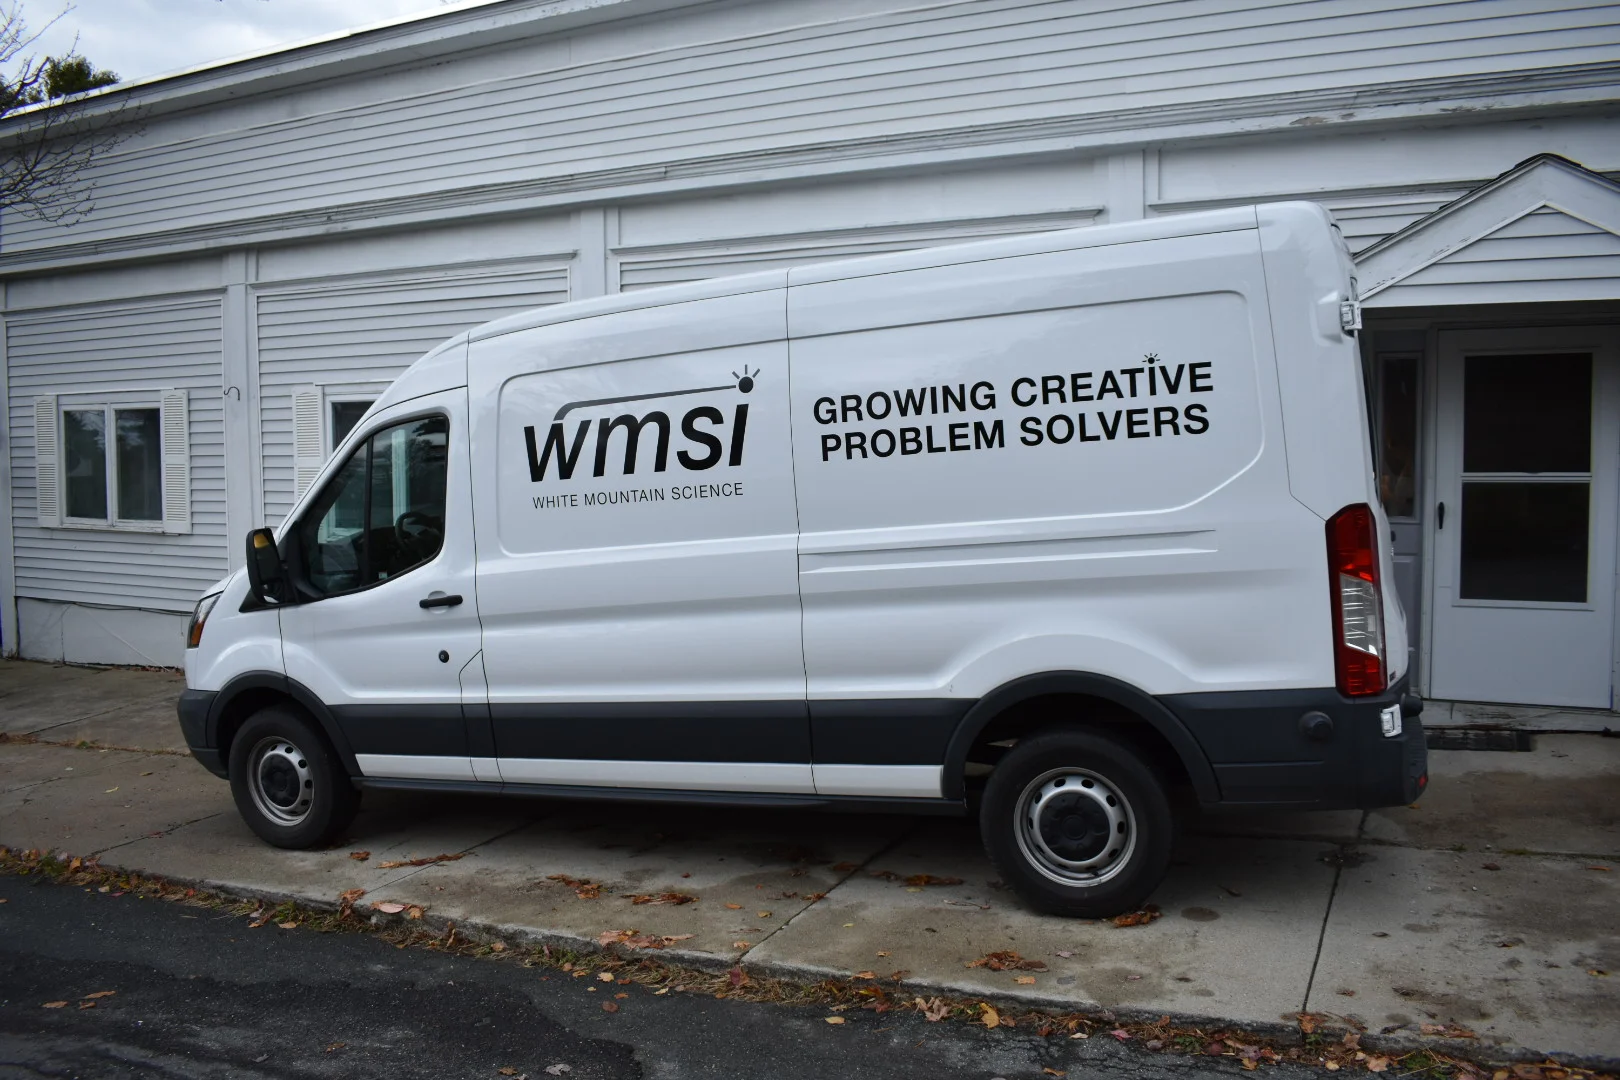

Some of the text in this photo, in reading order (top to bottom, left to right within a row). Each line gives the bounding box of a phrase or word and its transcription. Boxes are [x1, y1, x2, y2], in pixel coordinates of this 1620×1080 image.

[813, 357, 1214, 425] GROWING CREATIVE
[523, 377, 754, 483] wmsi
[820, 403, 1210, 462] PROBLEM SOLVERS
[532, 482, 744, 509] WHITE MOUNTAIN SCIENCE
